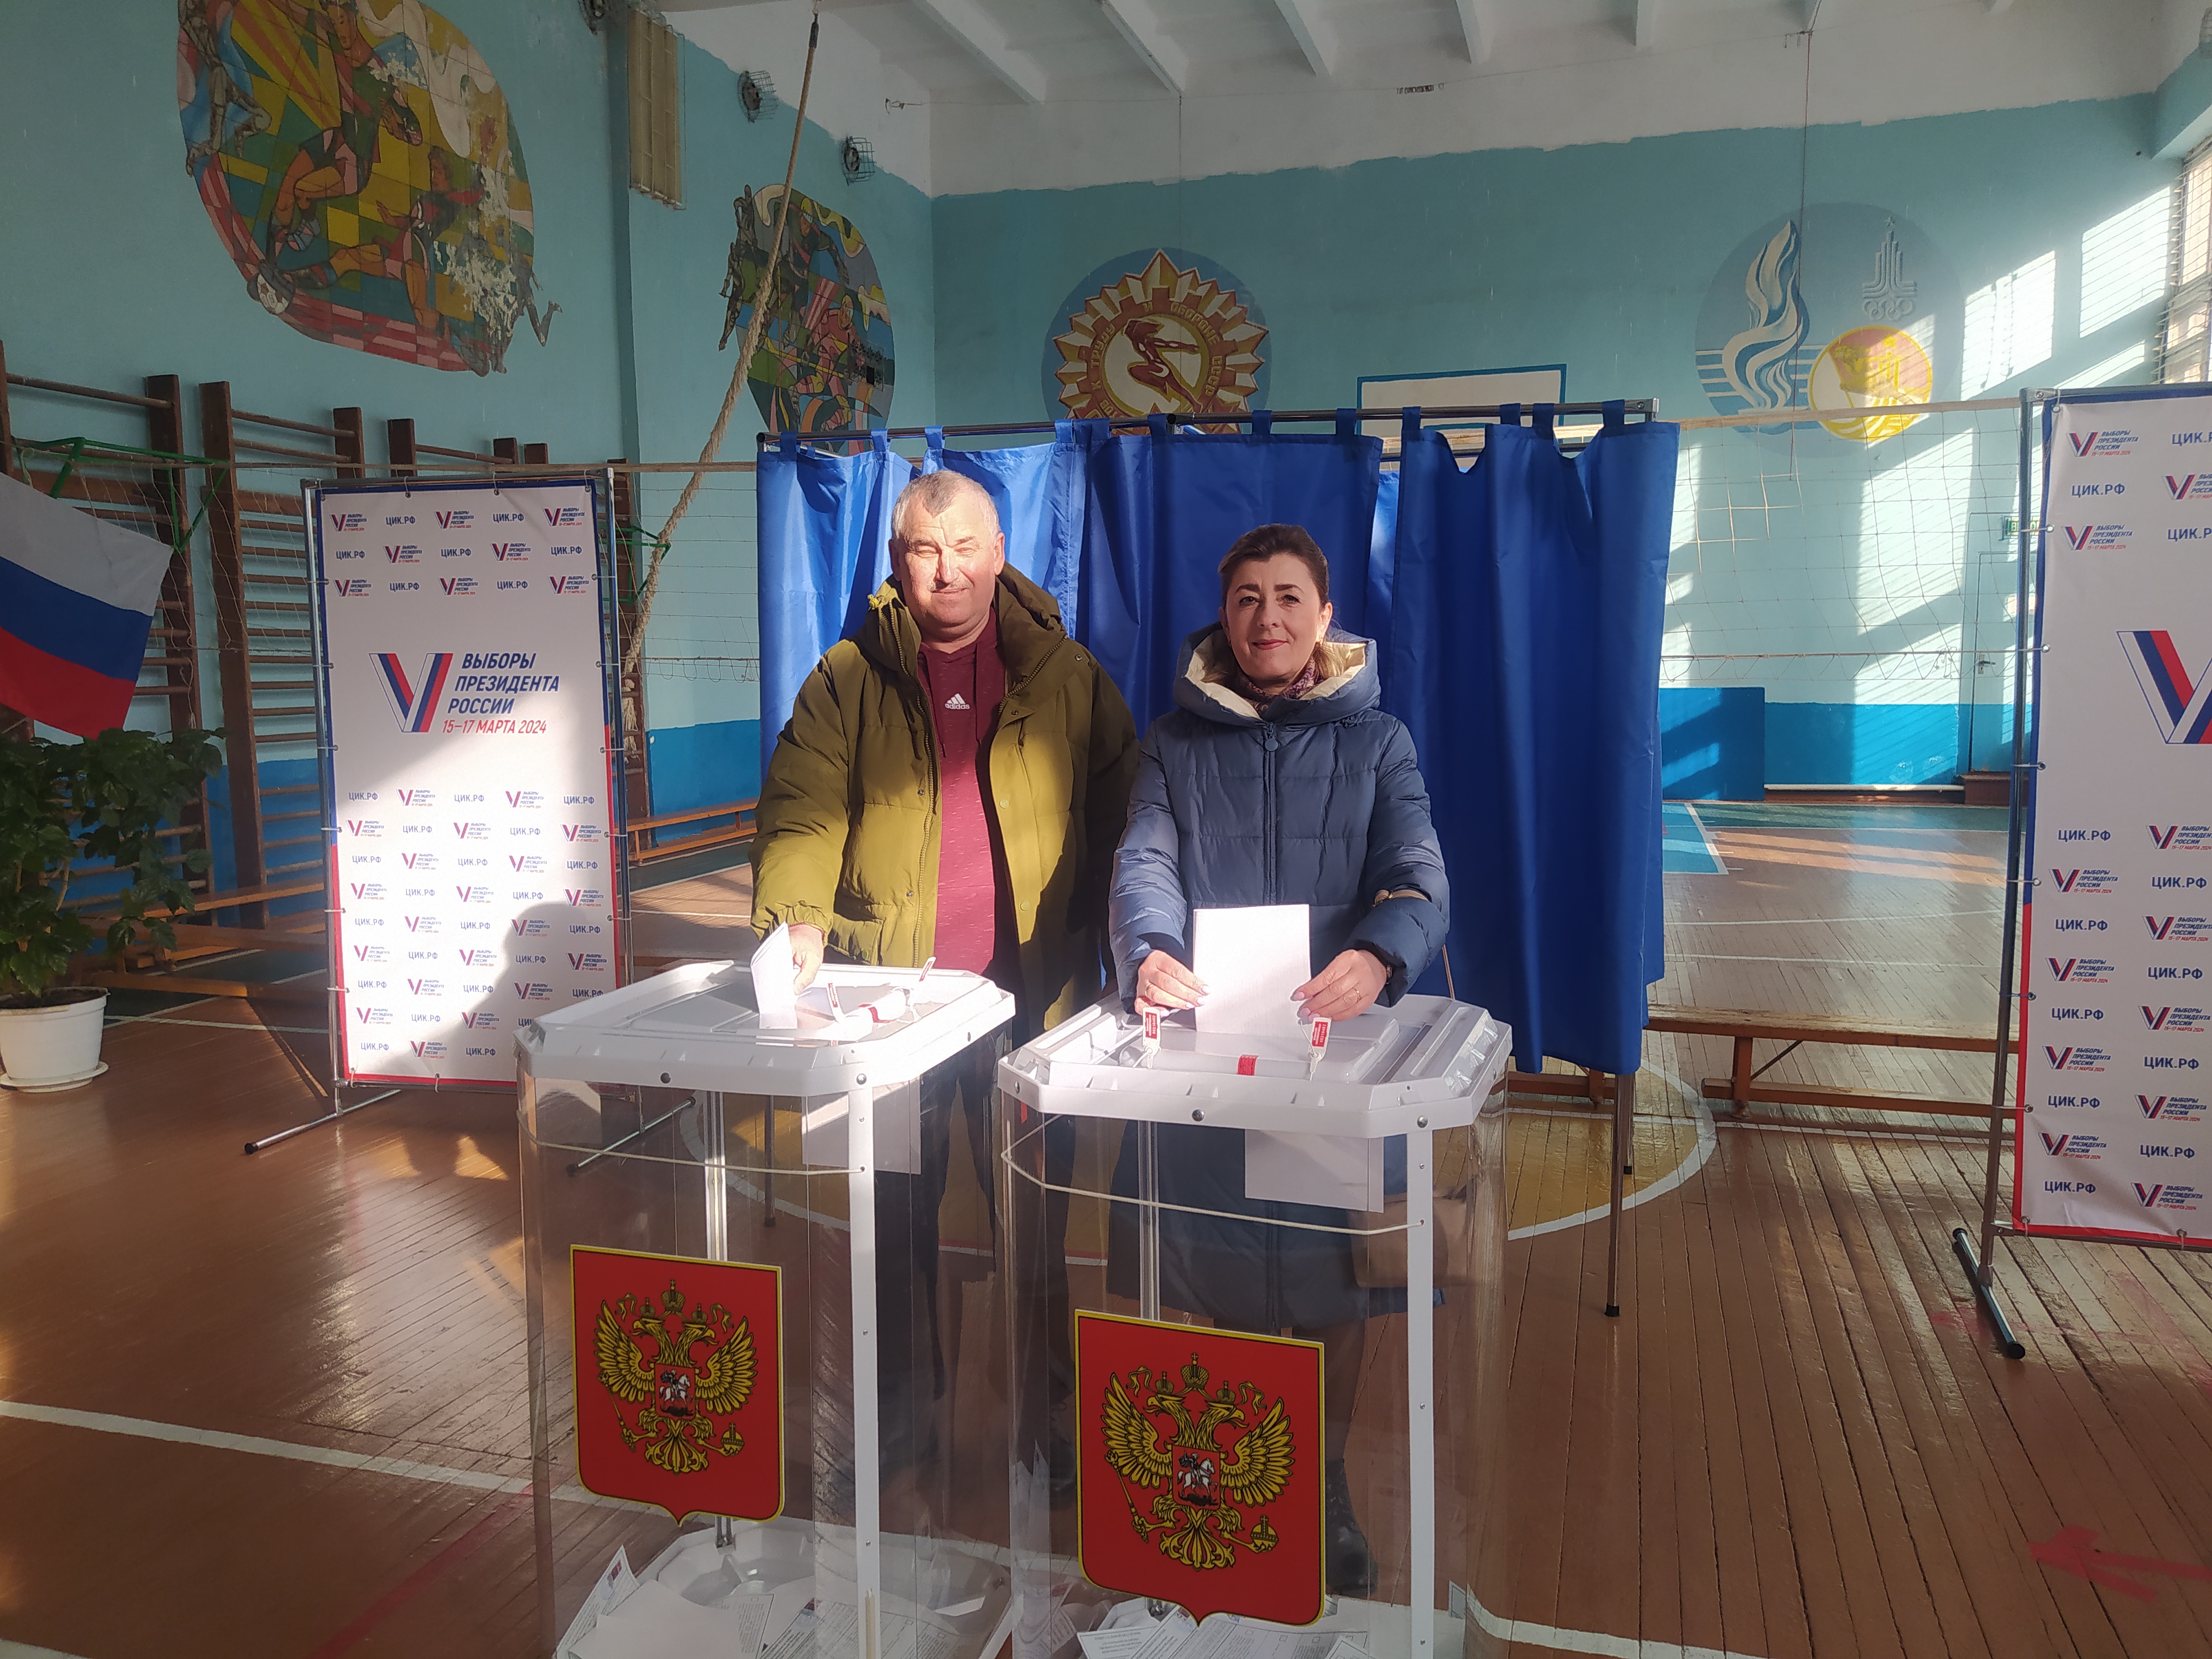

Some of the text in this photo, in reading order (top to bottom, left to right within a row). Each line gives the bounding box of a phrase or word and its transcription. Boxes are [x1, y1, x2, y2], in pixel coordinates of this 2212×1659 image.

[1143, 301, 1152, 312] И
[1170, 301, 1220, 345] ОБОРОНЕ
[1091, 324, 1115, 368] ТРУДУ
[1205, 355, 1223, 396] СССР
[1092, 380, 1101, 390] К
[2072, 483, 2125, 498] ЦИК.РФ
[386, 516, 415, 526] ЦИК.РФ
[493, 513, 524, 523] ЦИК.РФ
[2168, 528, 2212, 542] ЦИК.Р
[336, 551, 364, 560] ЦИК.РФ
[441, 549, 471, 558] ЦИК.РФ
[551, 546, 582, 556] ЦИК.РФ
[390, 582, 419, 592] ЦИК.РФ
[497, 581, 528, 590] ЦИК.РФ
[462, 653, 536, 669] ВЫБОРЫ
[455, 676, 559, 693] ПРЕЗИДЕНТА
[447, 698, 514, 713] РОССИИ
[476, 720, 515, 733] МАРТА
[518, 720, 546, 733] 2024
[349, 792, 378, 801] ЦИК.РФ
[455, 795, 484, 803] ЦИК.РФ
[564, 796, 594, 805] ЦИК.РФ
[403, 826, 432, 834] ЦИК.РФ
[2058, 830, 2110, 842] ЦИК.РФ
[352, 855, 381, 864] ЦИК.РФ
[458, 858, 488, 867] ЦИК.РФ
[567, 861, 598, 870] ЦИК.РФ
[2152, 877, 2206, 889] ЦИК.РФ
[406, 889, 435, 897] ЦИК.РФ
[513, 892, 543, 900] ЦИК.РФ
[461, 922, 490, 930] ЦИК.РФ
[570, 925, 600, 934] ЦИК.РФ
[2056, 919, 2107, 931] ЦИК.РФ
[516, 955, 546, 964] ЦИК.РФ
[2148, 967, 2202, 979] ЦИК.РФ
[358, 980, 387, 989] ЦИК.РФ
[463, 985, 493, 993] ЦИК.РФ
[411, 1014, 440, 1022] ЦИК.РФ
[2052, 1008, 2103, 1020] ЦИК.РФ
[361, 1042, 389, 1051] ЦИК.РФ
[466, 1047, 495, 1056] ЦИК.РФ
[2145, 1057, 2199, 1070] ЦИК.РФ
[2048, 1095, 2100, 1108] ЦИК.РФ
[2140, 1145, 2194, 1159] ЦИК.РФ
[2045, 1181, 2096, 1193] ЦИК.РФ
